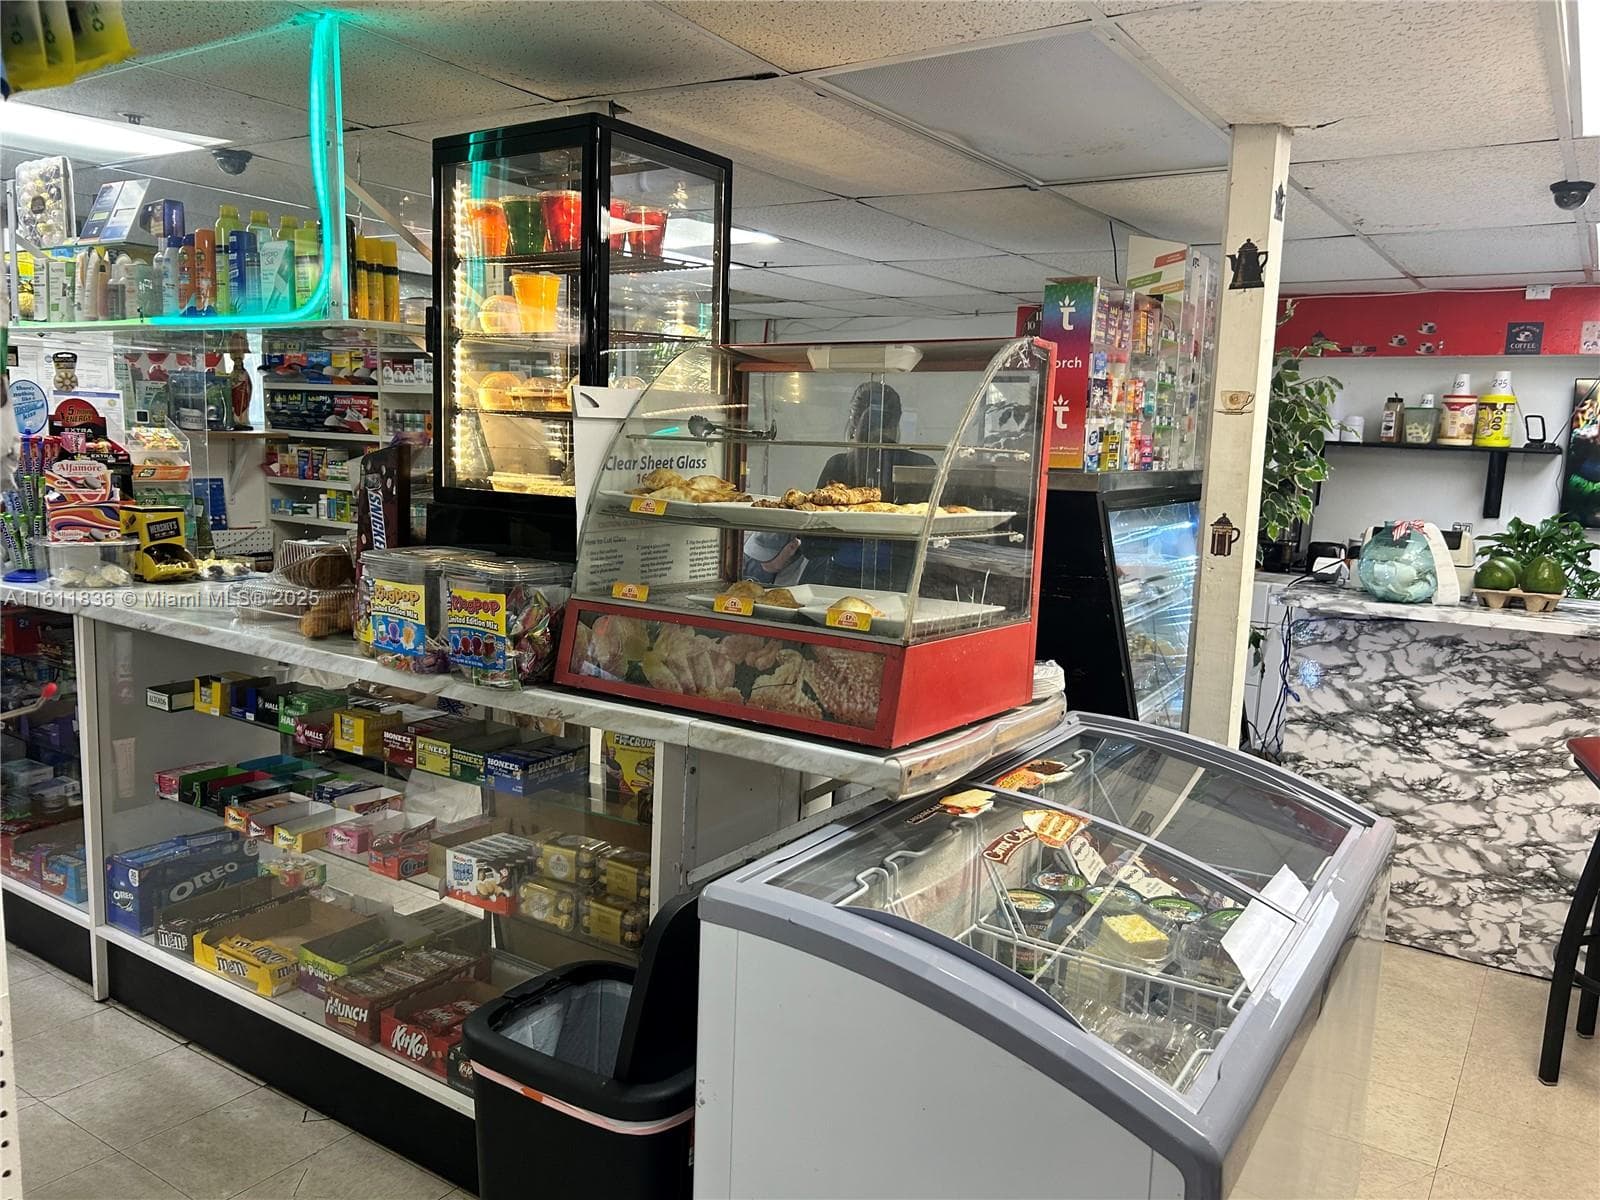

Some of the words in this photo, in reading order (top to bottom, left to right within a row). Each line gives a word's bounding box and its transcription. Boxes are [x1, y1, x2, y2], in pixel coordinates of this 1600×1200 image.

[1055, 356, 1082, 369] orch
[604, 455, 638, 471] Clear
[639, 455, 674, 470] Sheet
[677, 455, 707, 470] Glass
[149, 520, 178, 534] HERSHEY'S
[368, 490, 387, 551] SNICKE
[486, 619, 499, 631] Mix
[264, 701, 279, 711] HALL
[280, 715, 295, 726] HAL
[304, 729, 324, 740] HALLS
[487, 757, 519, 771] HONEES
[528, 752, 573, 774] HONEES
[169, 861, 239, 903] OREO
[112, 890, 134, 901] OREO
[325, 996, 369, 1023] MUNCH
